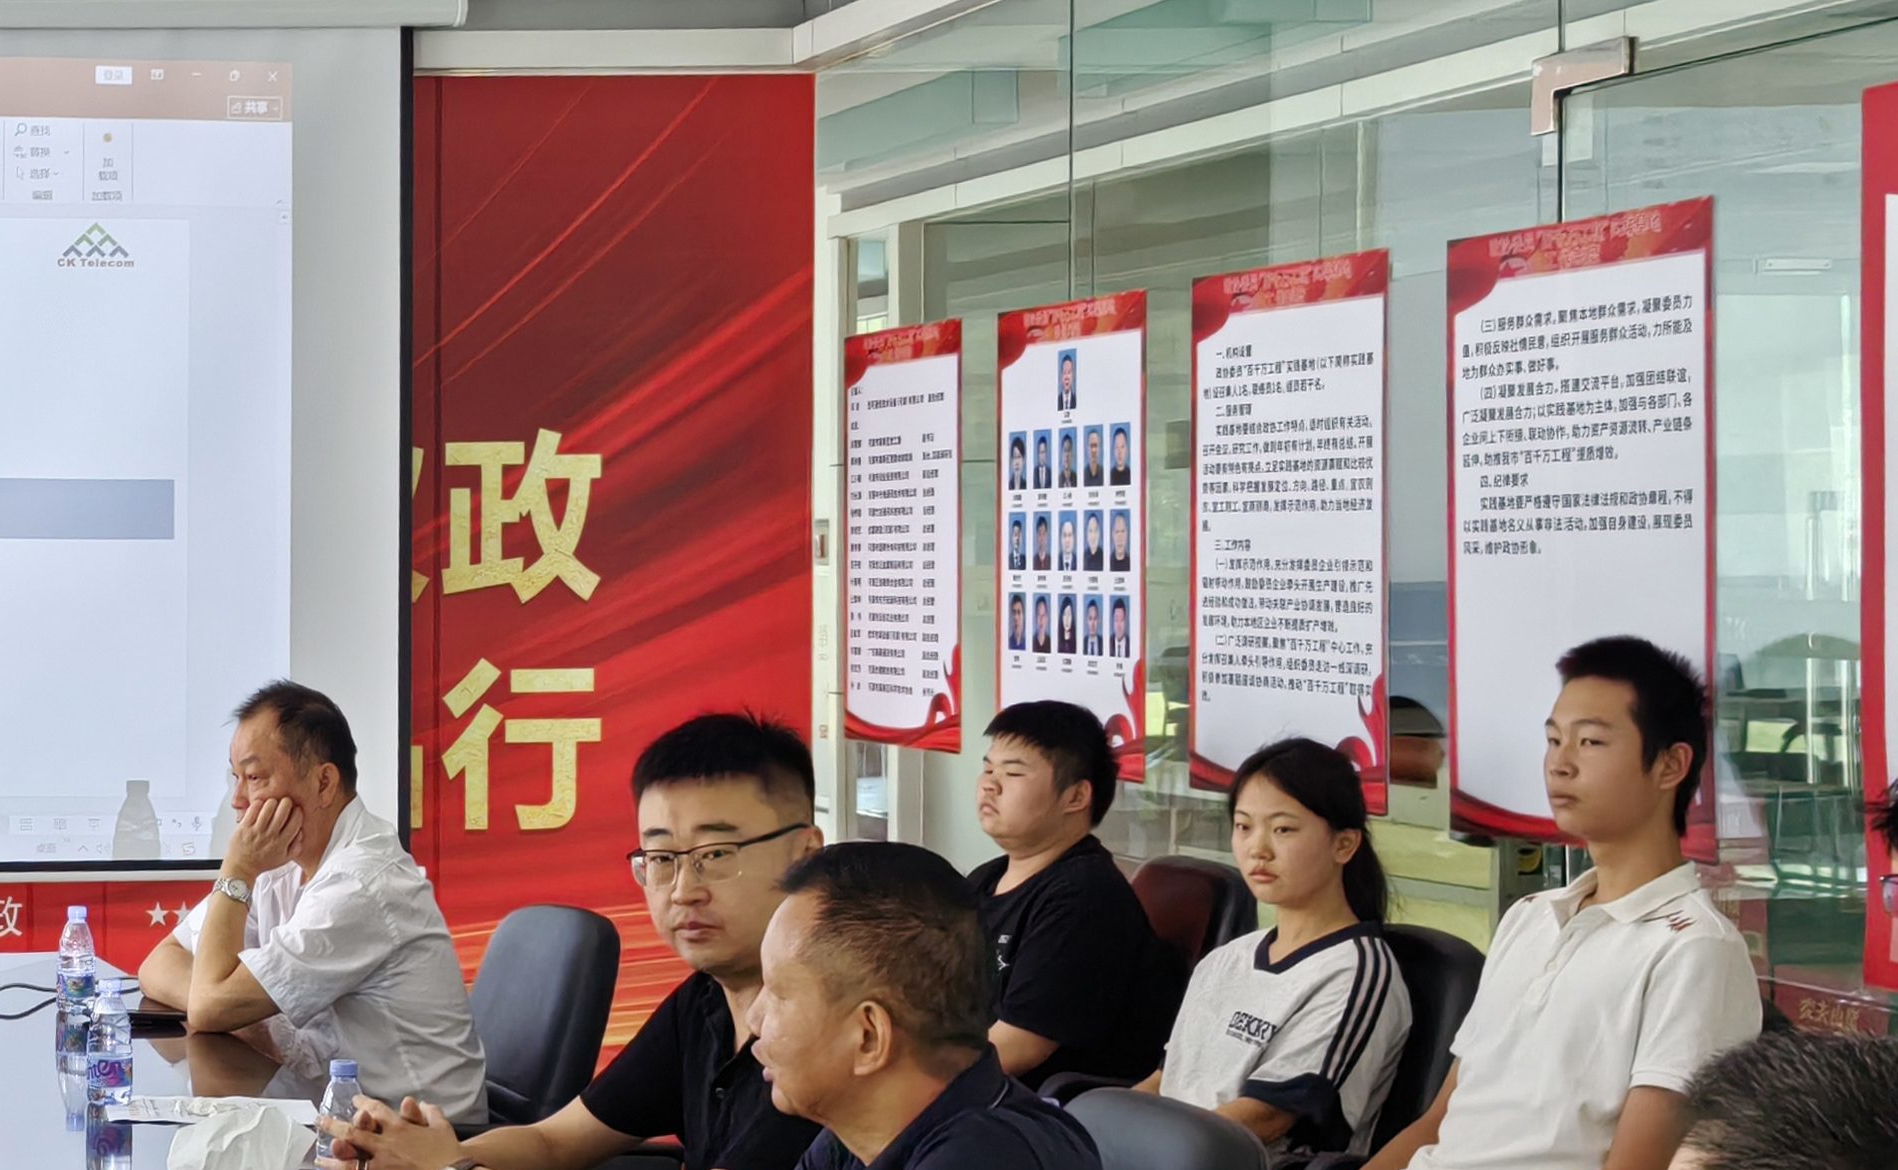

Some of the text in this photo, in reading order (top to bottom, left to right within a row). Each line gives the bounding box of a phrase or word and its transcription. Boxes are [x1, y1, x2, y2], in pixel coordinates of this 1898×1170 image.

[244, 100, 269, 114] 共享
[57, 257, 135, 268] CK Telecom
[412, 428, 602, 604] 政
[411, 657, 602, 831] 行
